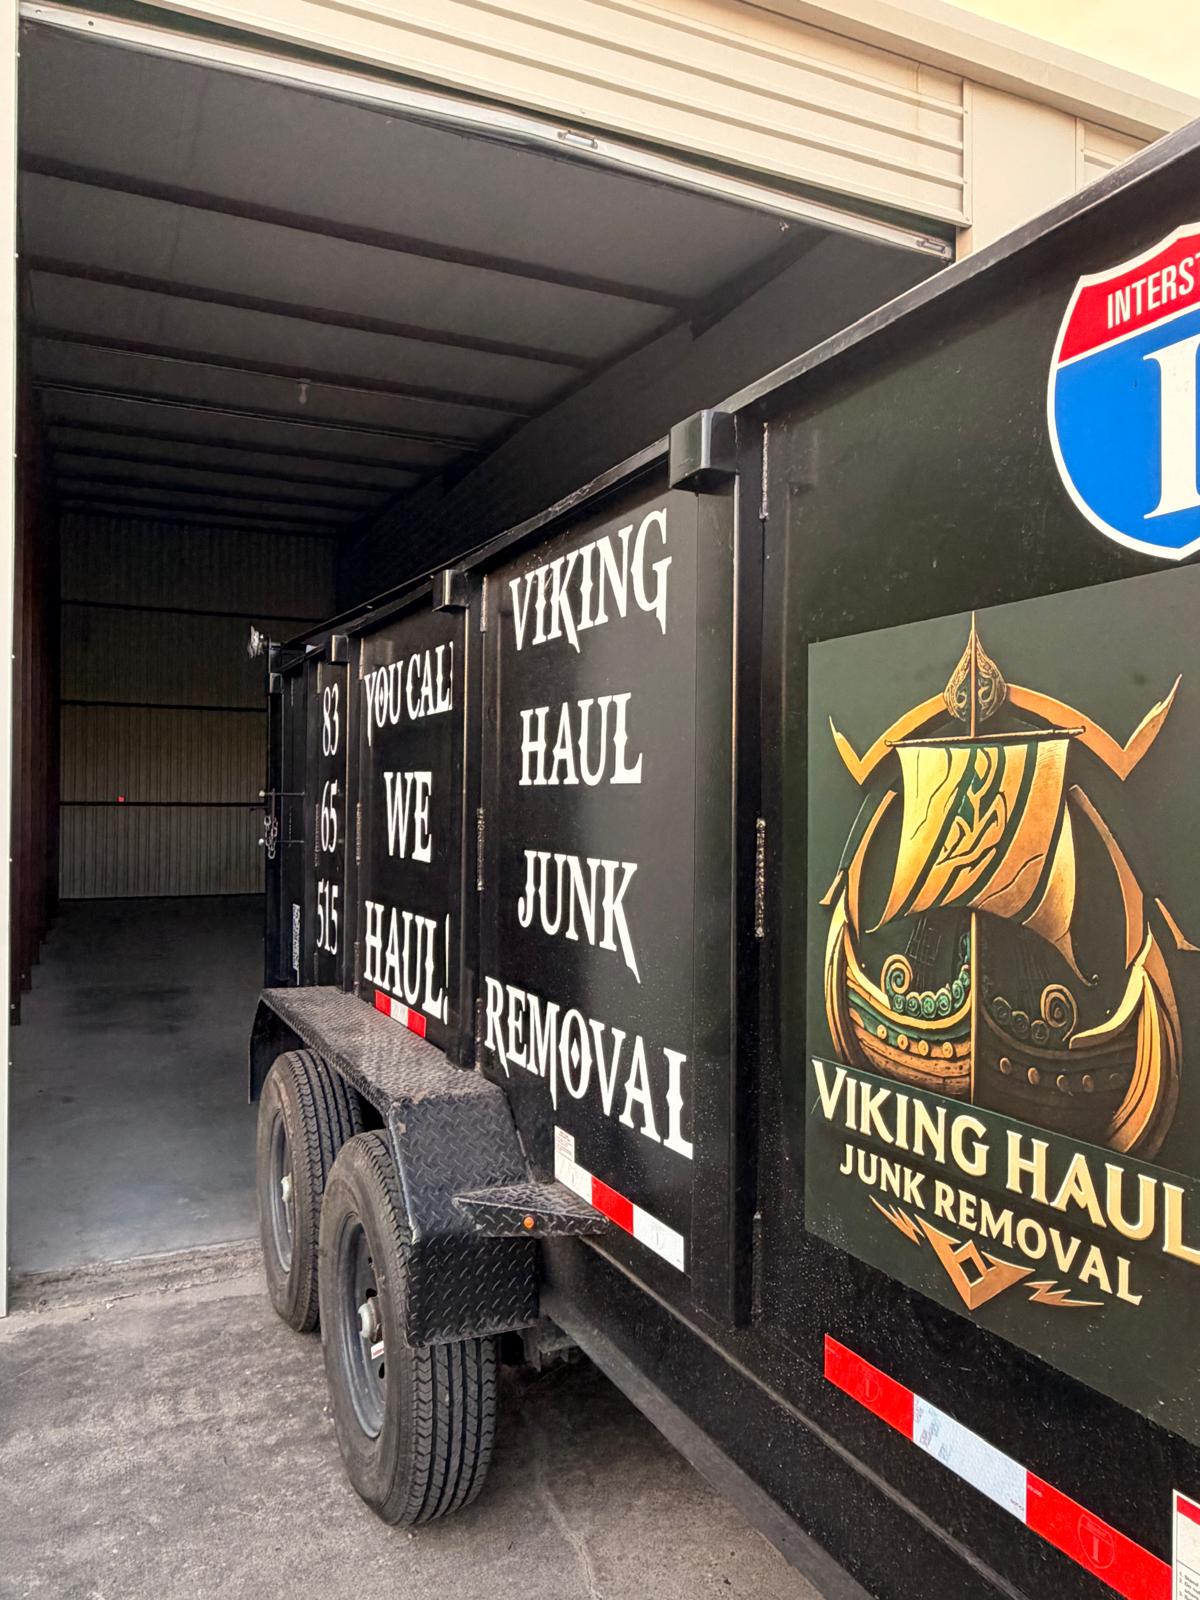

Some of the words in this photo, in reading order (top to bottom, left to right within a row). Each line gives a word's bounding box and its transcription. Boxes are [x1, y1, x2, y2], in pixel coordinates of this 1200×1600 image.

[1107, 254, 1200, 330] INTERS
[509, 508, 673, 654] VIKING
[322, 683, 339, 757] 83
[364, 661, 404, 747] YOU
[518, 692, 644, 787] HAUL
[320, 779, 338, 853] 65
[383, 771, 432, 863] WE
[316, 878, 339, 956] 515
[517, 849, 641, 985] JUNK
[811, 1057, 990, 1177] VIKING
[1005, 1129, 1200, 1266] HAUL
[839, 1143, 926, 1210] JUNK
[933, 1178, 1143, 1306] REMOVAL
